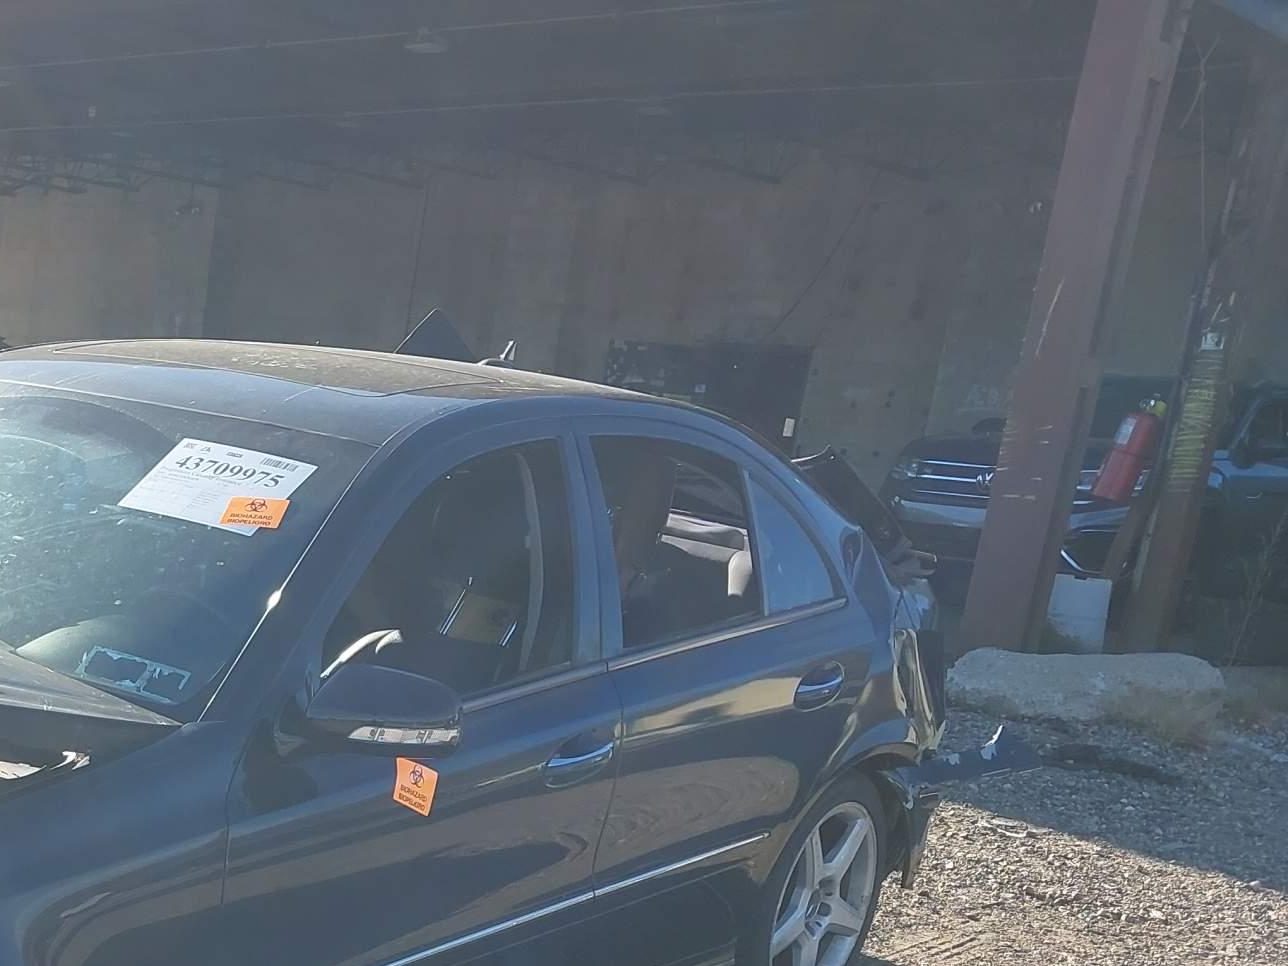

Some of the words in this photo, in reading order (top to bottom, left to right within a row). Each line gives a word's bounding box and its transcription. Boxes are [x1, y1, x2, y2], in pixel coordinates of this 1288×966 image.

[175, 455, 285, 488] 43709975
[230, 512, 273, 521] BIOHAZARD
[400, 784, 427, 802] BIOHAZARD
